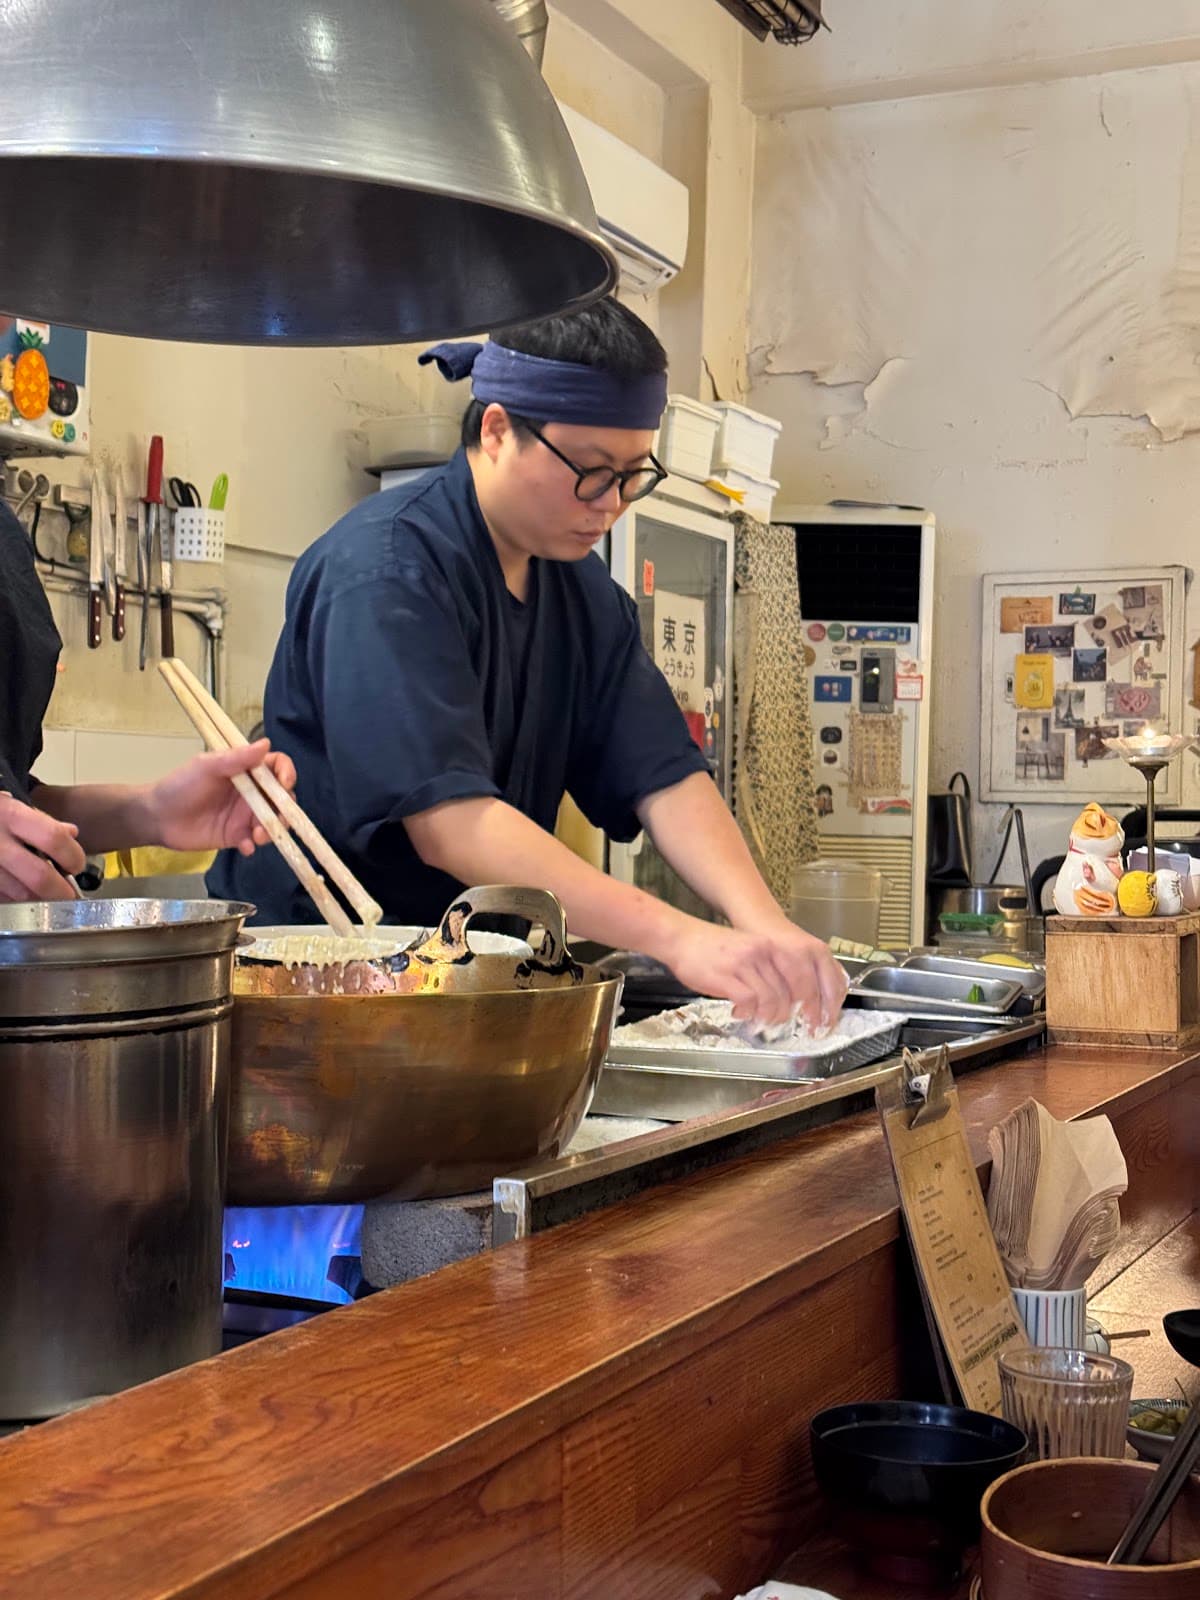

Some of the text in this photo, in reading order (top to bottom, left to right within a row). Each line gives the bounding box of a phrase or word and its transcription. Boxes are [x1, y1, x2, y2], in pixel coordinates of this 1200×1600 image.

[662, 616, 697, 656] 東京
[663, 657, 696, 680] とうきょう
